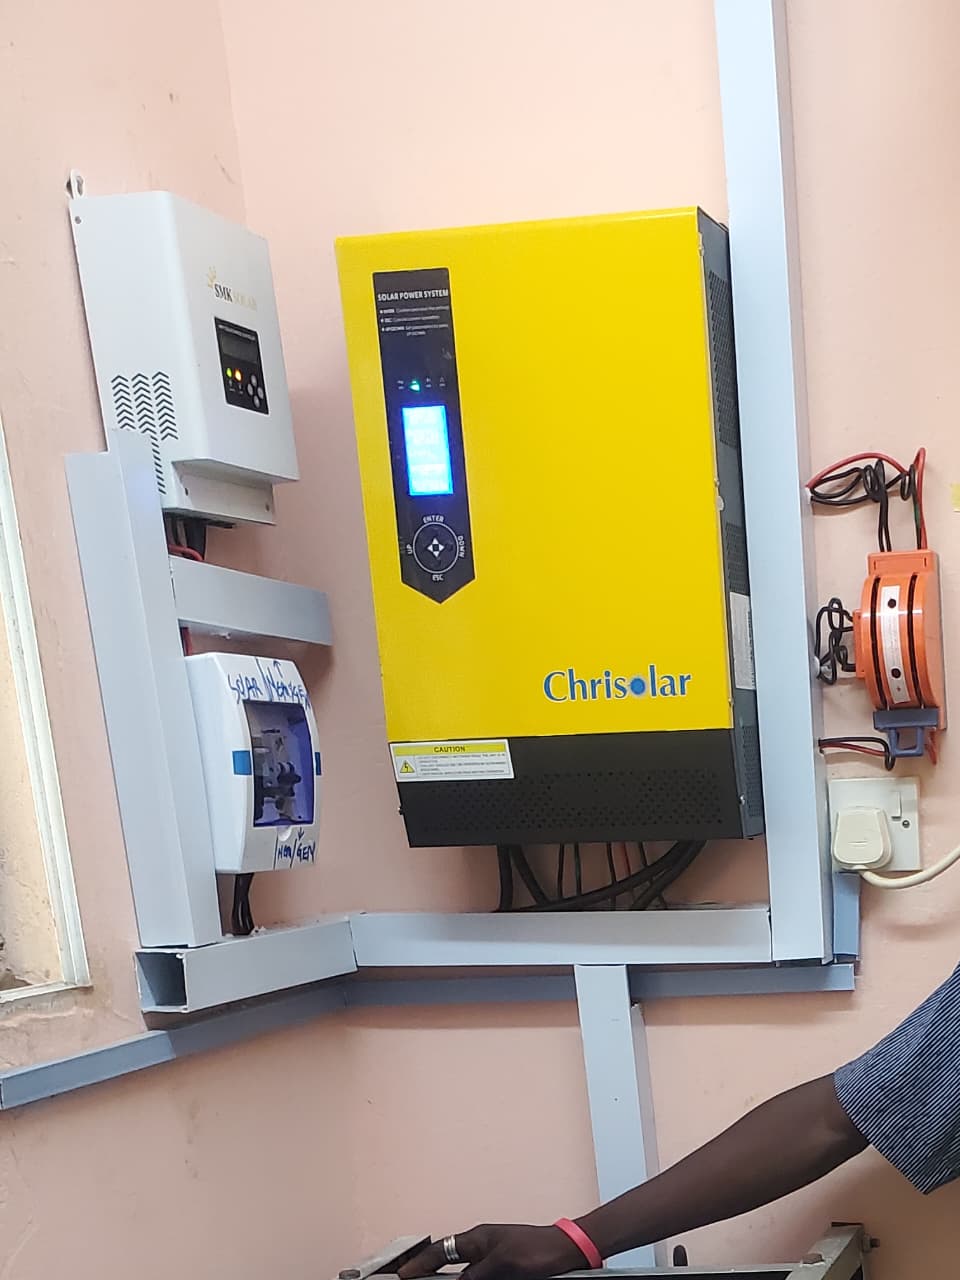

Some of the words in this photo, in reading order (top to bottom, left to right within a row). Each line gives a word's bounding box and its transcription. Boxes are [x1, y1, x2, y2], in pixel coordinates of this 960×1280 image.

[377, 293, 399, 302] SOLAR
[400, 291, 423, 300] POWER
[424, 289, 449, 298] SYSTEM
[423, 515, 444, 523] ENTER
[543, 664, 691, 702] Chrisolar
[433, 745, 466, 753] CAUTION
